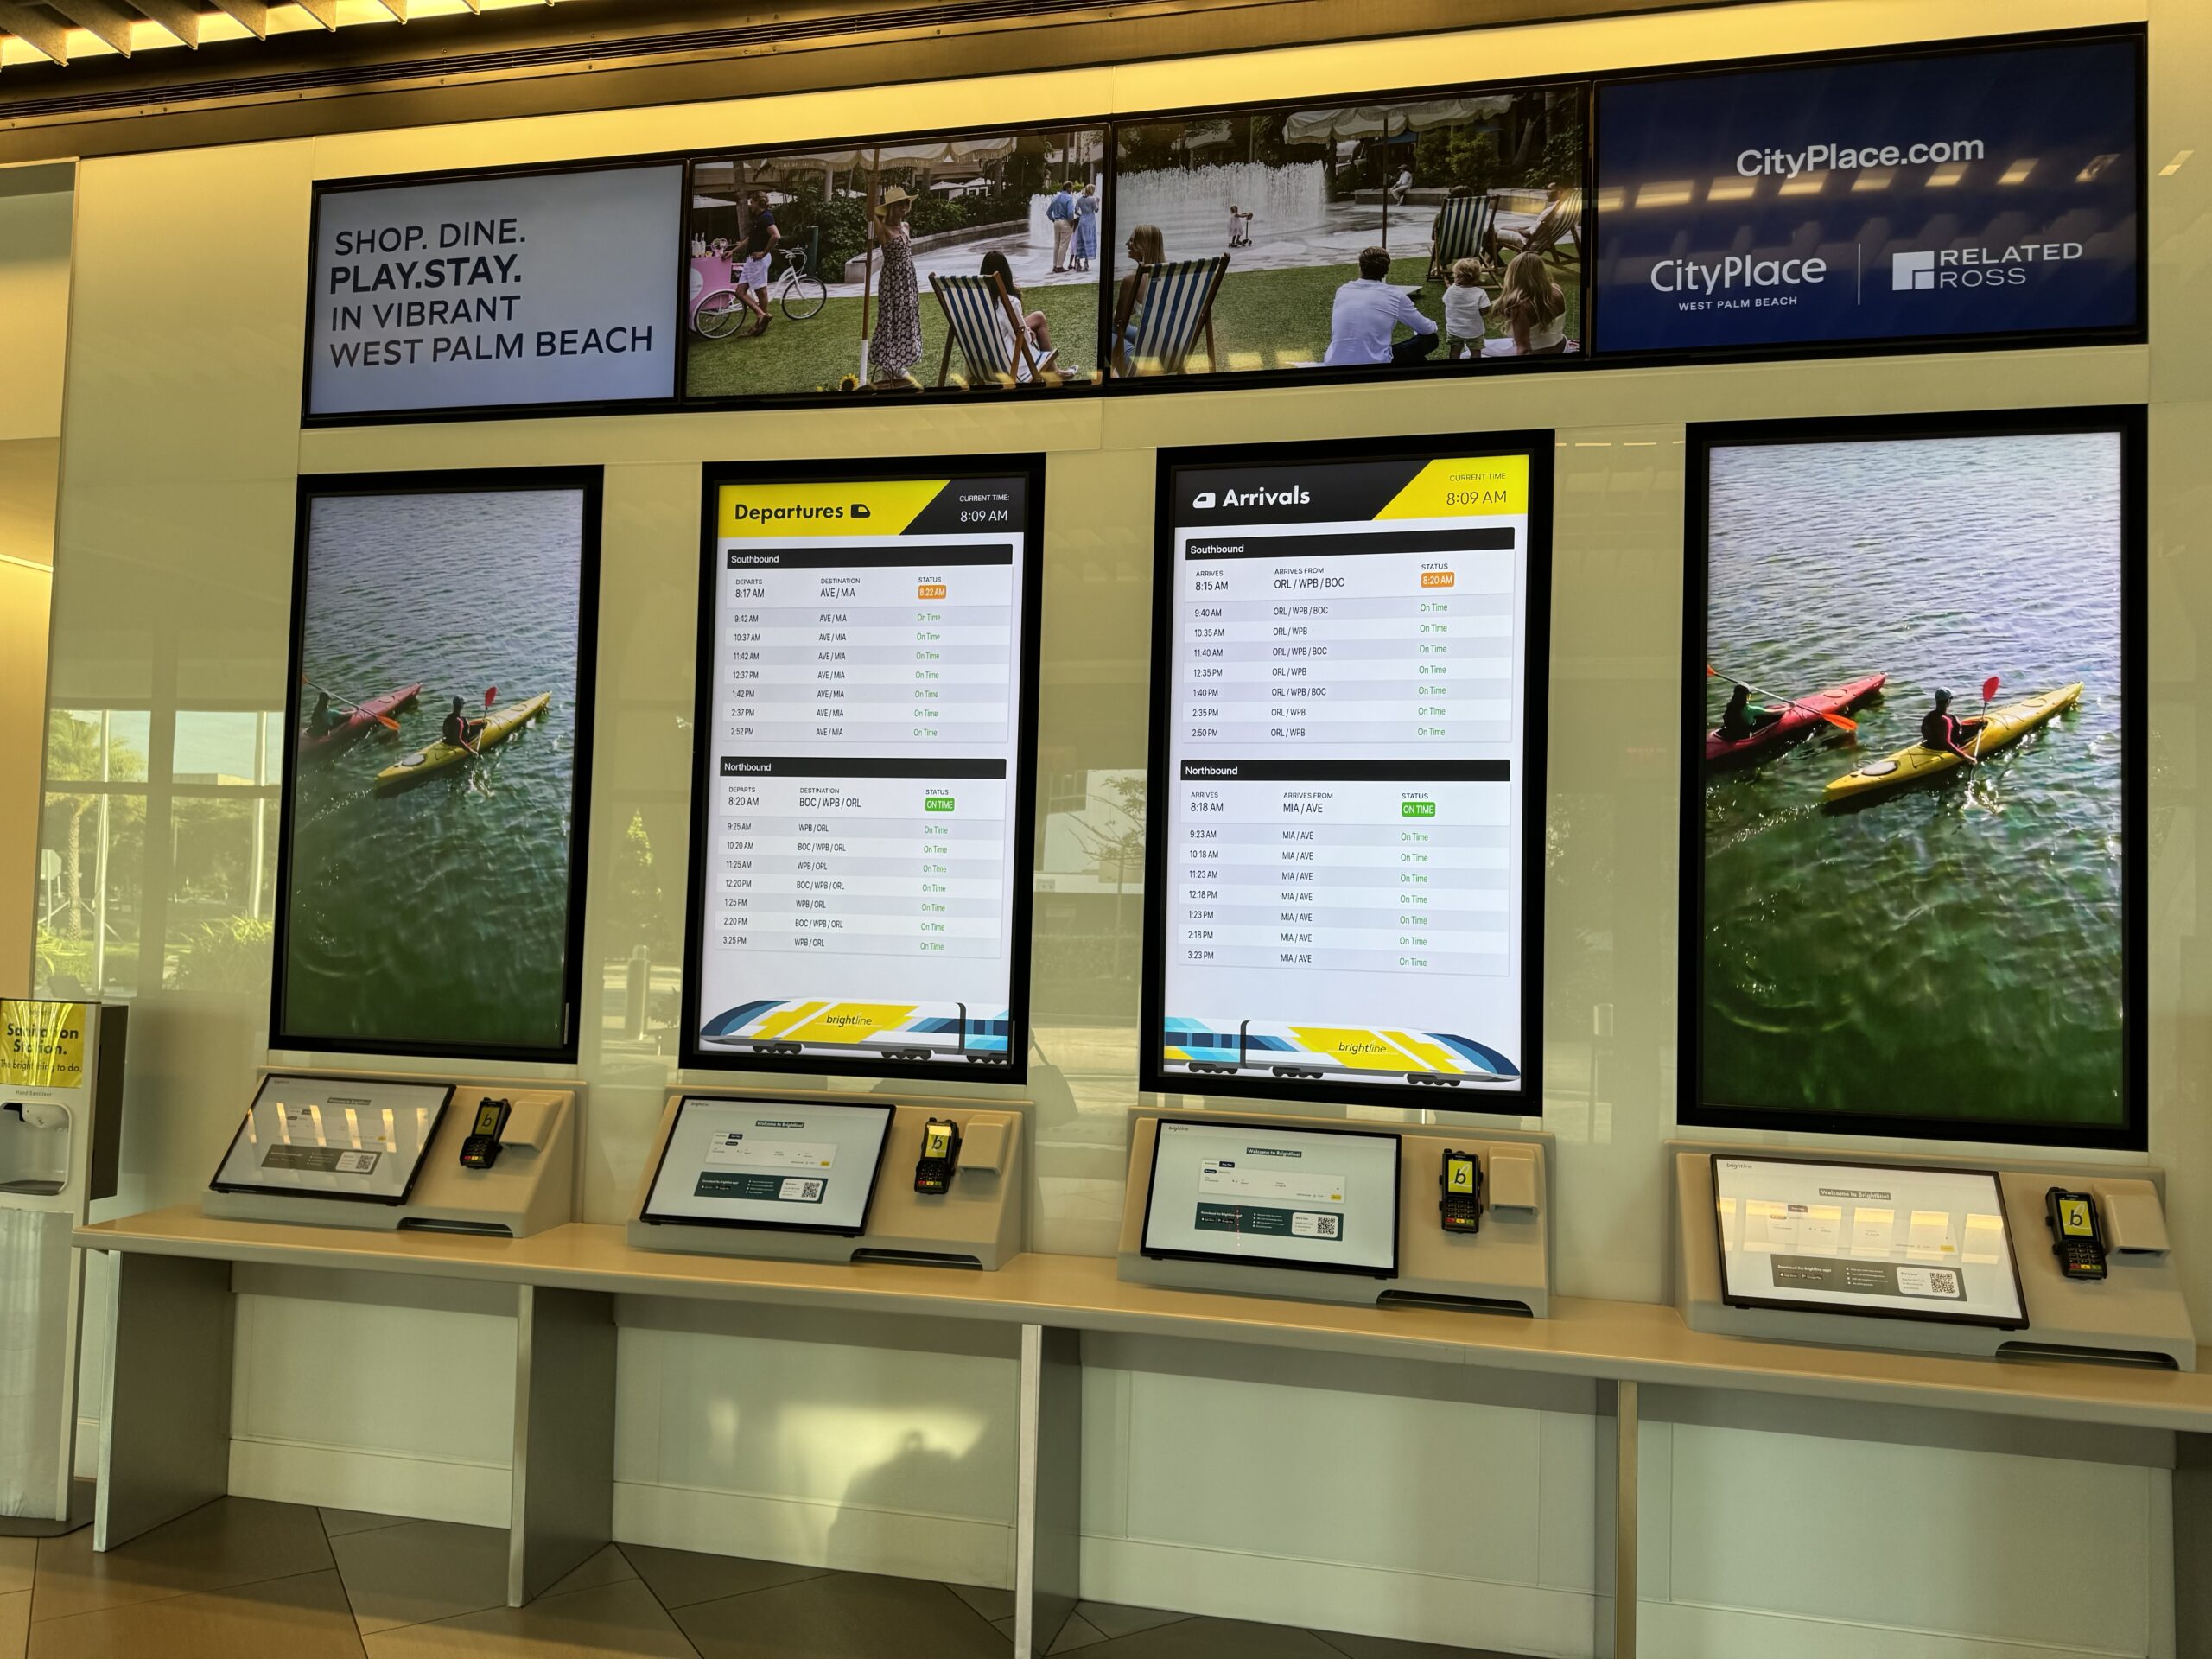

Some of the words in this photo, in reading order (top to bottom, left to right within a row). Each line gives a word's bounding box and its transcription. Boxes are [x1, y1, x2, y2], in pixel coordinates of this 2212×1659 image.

[1735, 140, 1984, 178] CityPlace.com
[335, 226, 427, 256] SHOP.
[440, 219, 525, 248] DINE.
[1941, 243, 2082, 266] RELATED
[331, 254, 521, 294] PLAY.STAY.
[1651, 255, 1826, 295] CityPlace
[1941, 268, 2025, 288] ROSS
[1679, 302, 1713, 311] WEST
[1718, 299, 1750, 308] PALM
[1756, 296, 1796, 307] BEACH
[333, 306, 361, 331] IN
[373, 296, 520, 328] VIBRANT
[330, 339, 423, 368] WEST
[433, 334, 523, 362] PALM
[537, 326, 652, 356] BEACH
[1223, 485, 1310, 506] Arrivals
[1446, 492, 1478, 505] 8:09
[1483, 491, 1506, 503] AM
[735, 505, 843, 524] Departures
[961, 511, 986, 522] 8:09
[988, 510, 1007, 521] AM
[1191, 544, 1244, 554] Southbound
[732, 555, 779, 563] Southbound
[1274, 579, 1291, 588] ORL
[1299, 579, 1318, 588] WPB
[1325, 577, 1344, 588] BOC
[1423, 575, 1439, 584] 8:20
[1440, 575, 1452, 583] AM
[1196, 582, 1212, 590] 8:15
[1215, 581, 1228, 590] AM
[736, 589, 750, 598] 8:17
[821, 588, 835, 597] AVE
[842, 588, 855, 596] MIA
[728, 797, 745, 805] 8:20
[747, 797, 759, 805] AM
[800, 798, 816, 806] BOC
[823, 798, 840, 807] WPB
[846, 798, 861, 807] ORL
[927, 800, 937, 809] ON
[938, 800, 953, 809] TIME
[1191, 803, 1208, 811] 8:18
[1210, 803, 1224, 811] AM
[1284, 804, 1299, 812] MIA
[1306, 804, 1322, 812] AVE
[1403, 805, 1414, 814] ON
[1415, 805, 1433, 815] TIME
[1188, 950, 1202, 959] 3:23
[1410, 958, 1427, 967] Time
[827, 1014, 872, 1027] brightline
[1339, 1041, 1386, 1054] brightline
[57, 1063, 65, 1071] to
[68, 1063, 81, 1072] do.
